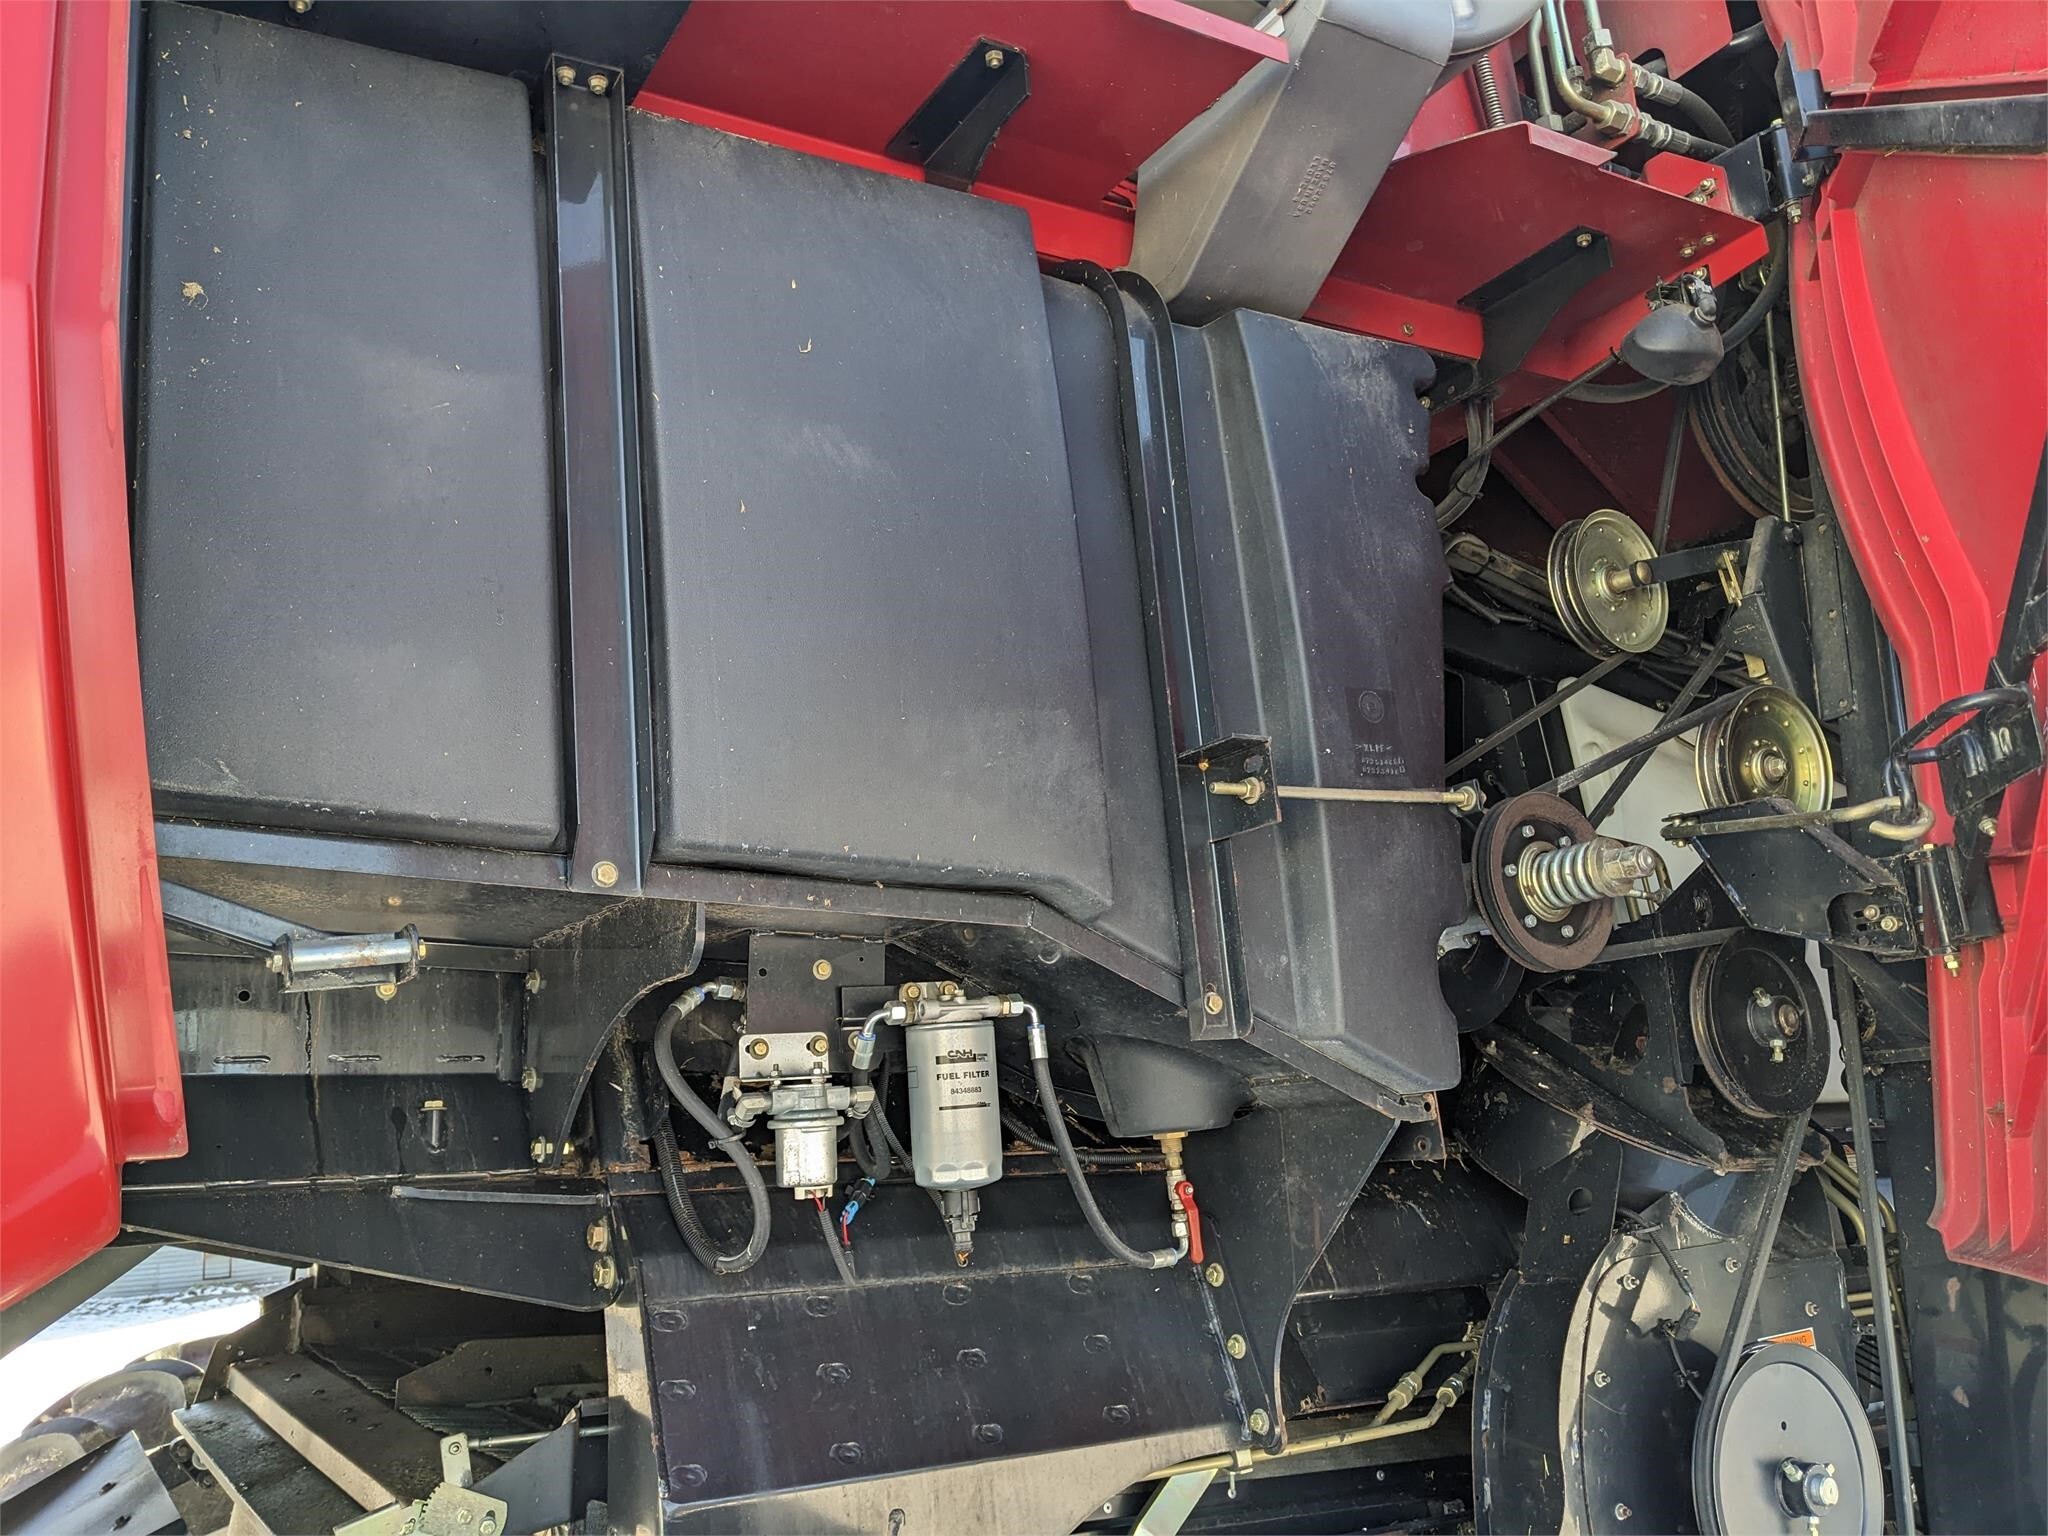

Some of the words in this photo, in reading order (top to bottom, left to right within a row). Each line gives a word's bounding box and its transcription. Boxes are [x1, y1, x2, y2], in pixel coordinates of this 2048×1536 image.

[947, 1049, 973, 1058] CNH
[936, 1073, 961, 1081] FUEL
[963, 1070, 990, 1078] FILTER
